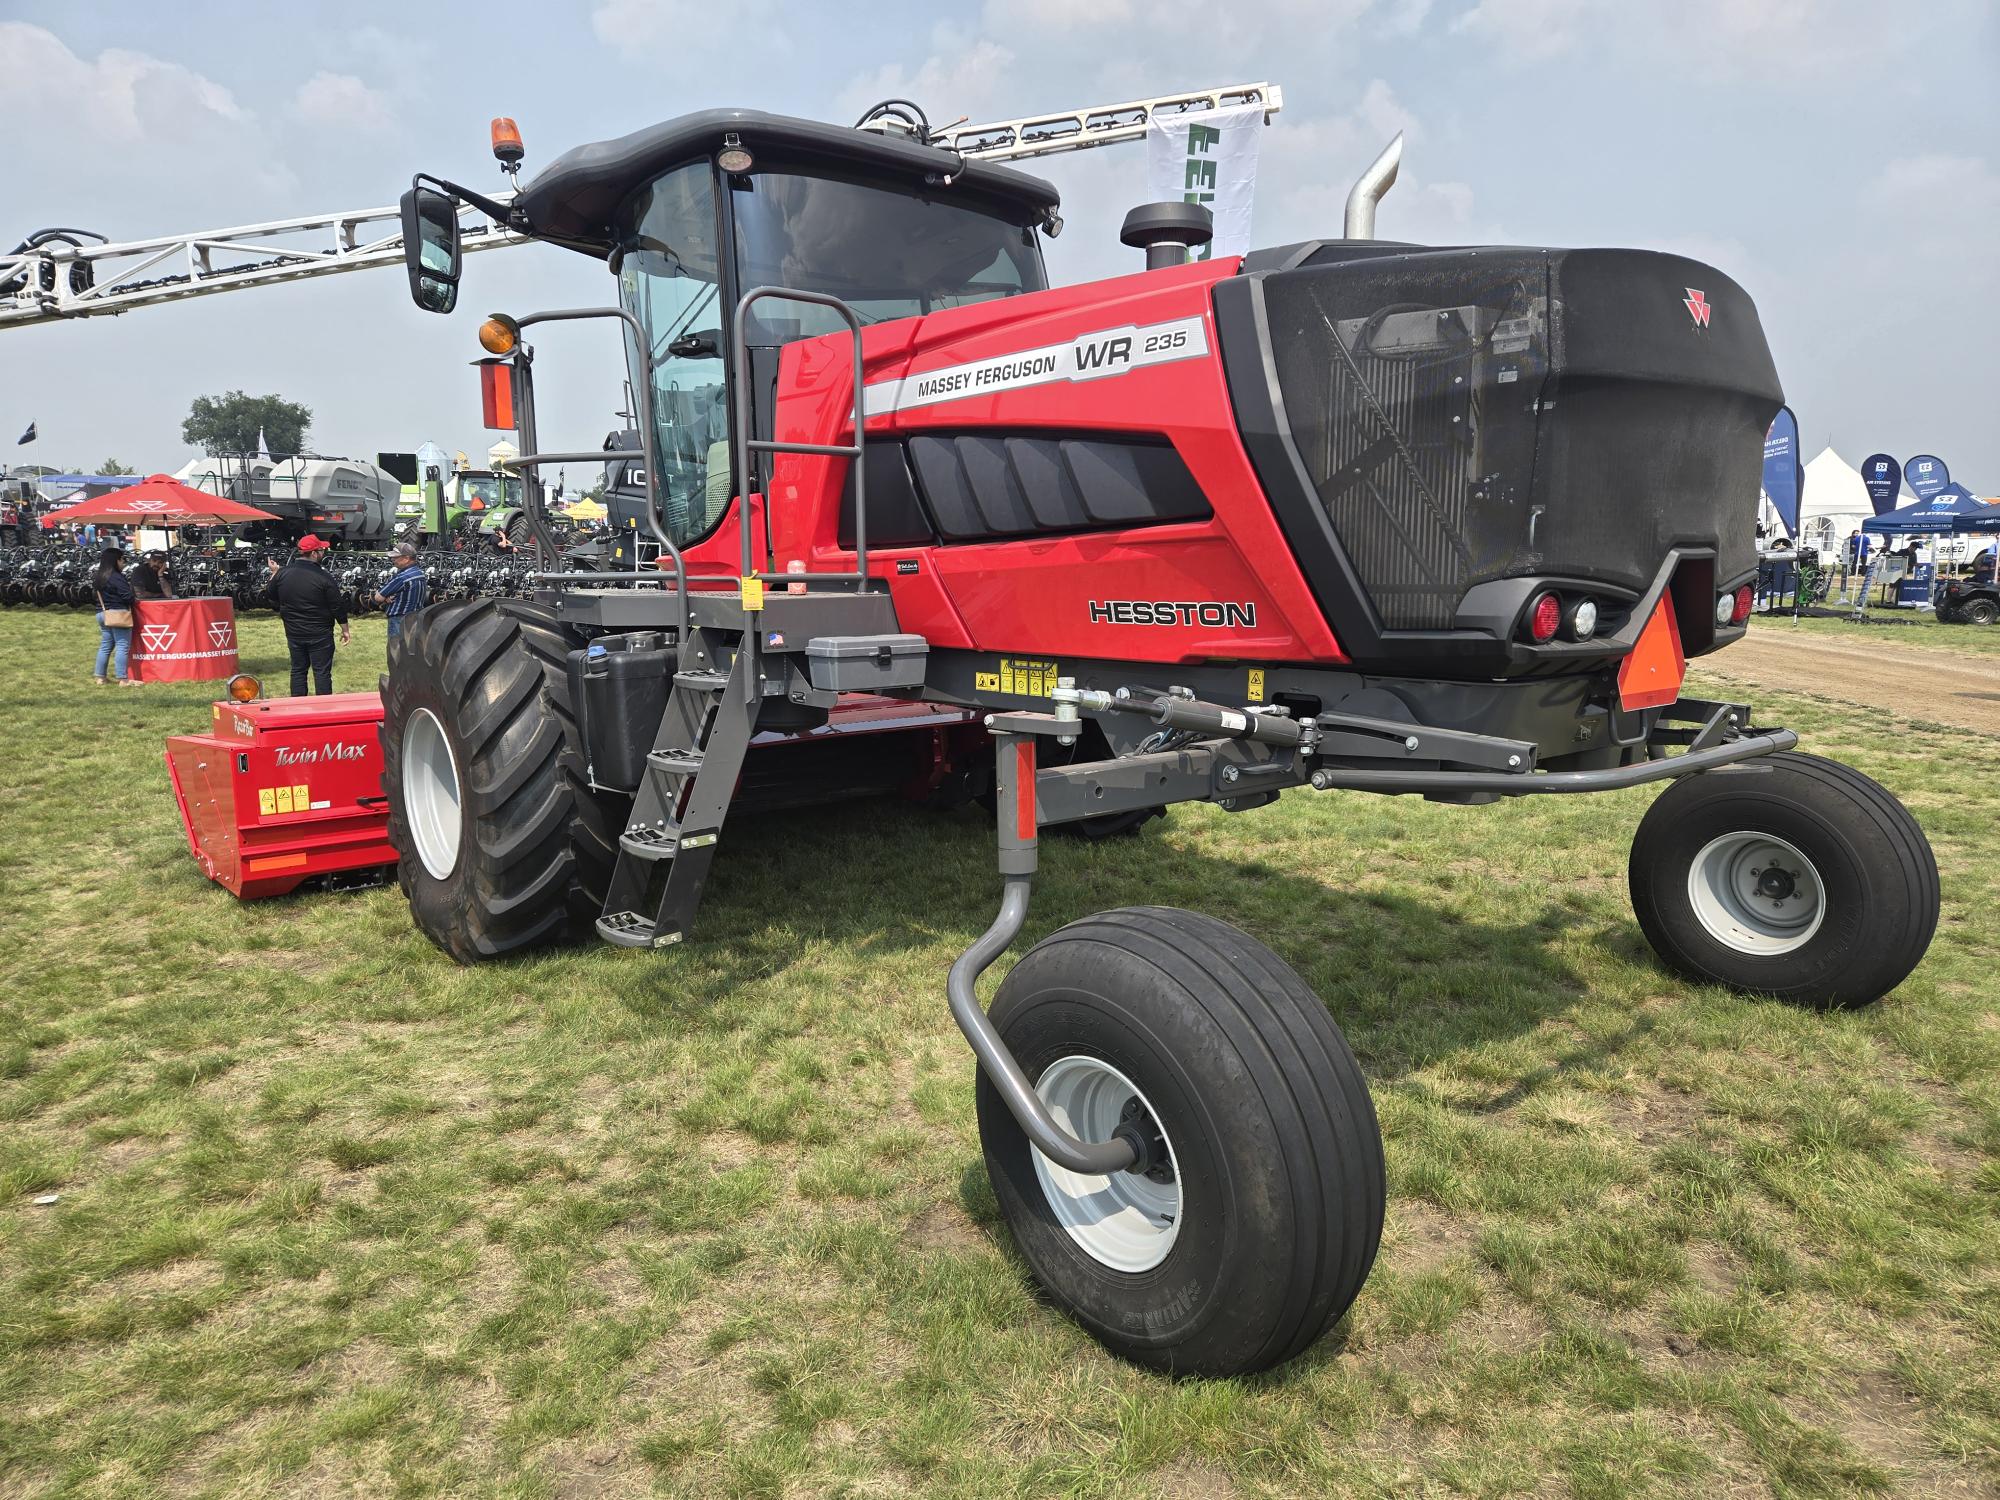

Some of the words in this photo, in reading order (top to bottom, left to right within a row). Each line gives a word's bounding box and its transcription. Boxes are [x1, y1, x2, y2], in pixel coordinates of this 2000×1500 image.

[918, 372, 971, 397] MASSEY
[975, 355, 1056, 386] FERGUSON
[1076, 336, 1133, 371] WR
[1144, 330, 1188, 352] 235
[1088, 600, 1257, 628] HESSTON
[274, 746, 318, 767] Twin
[320, 742, 367, 761] Max
